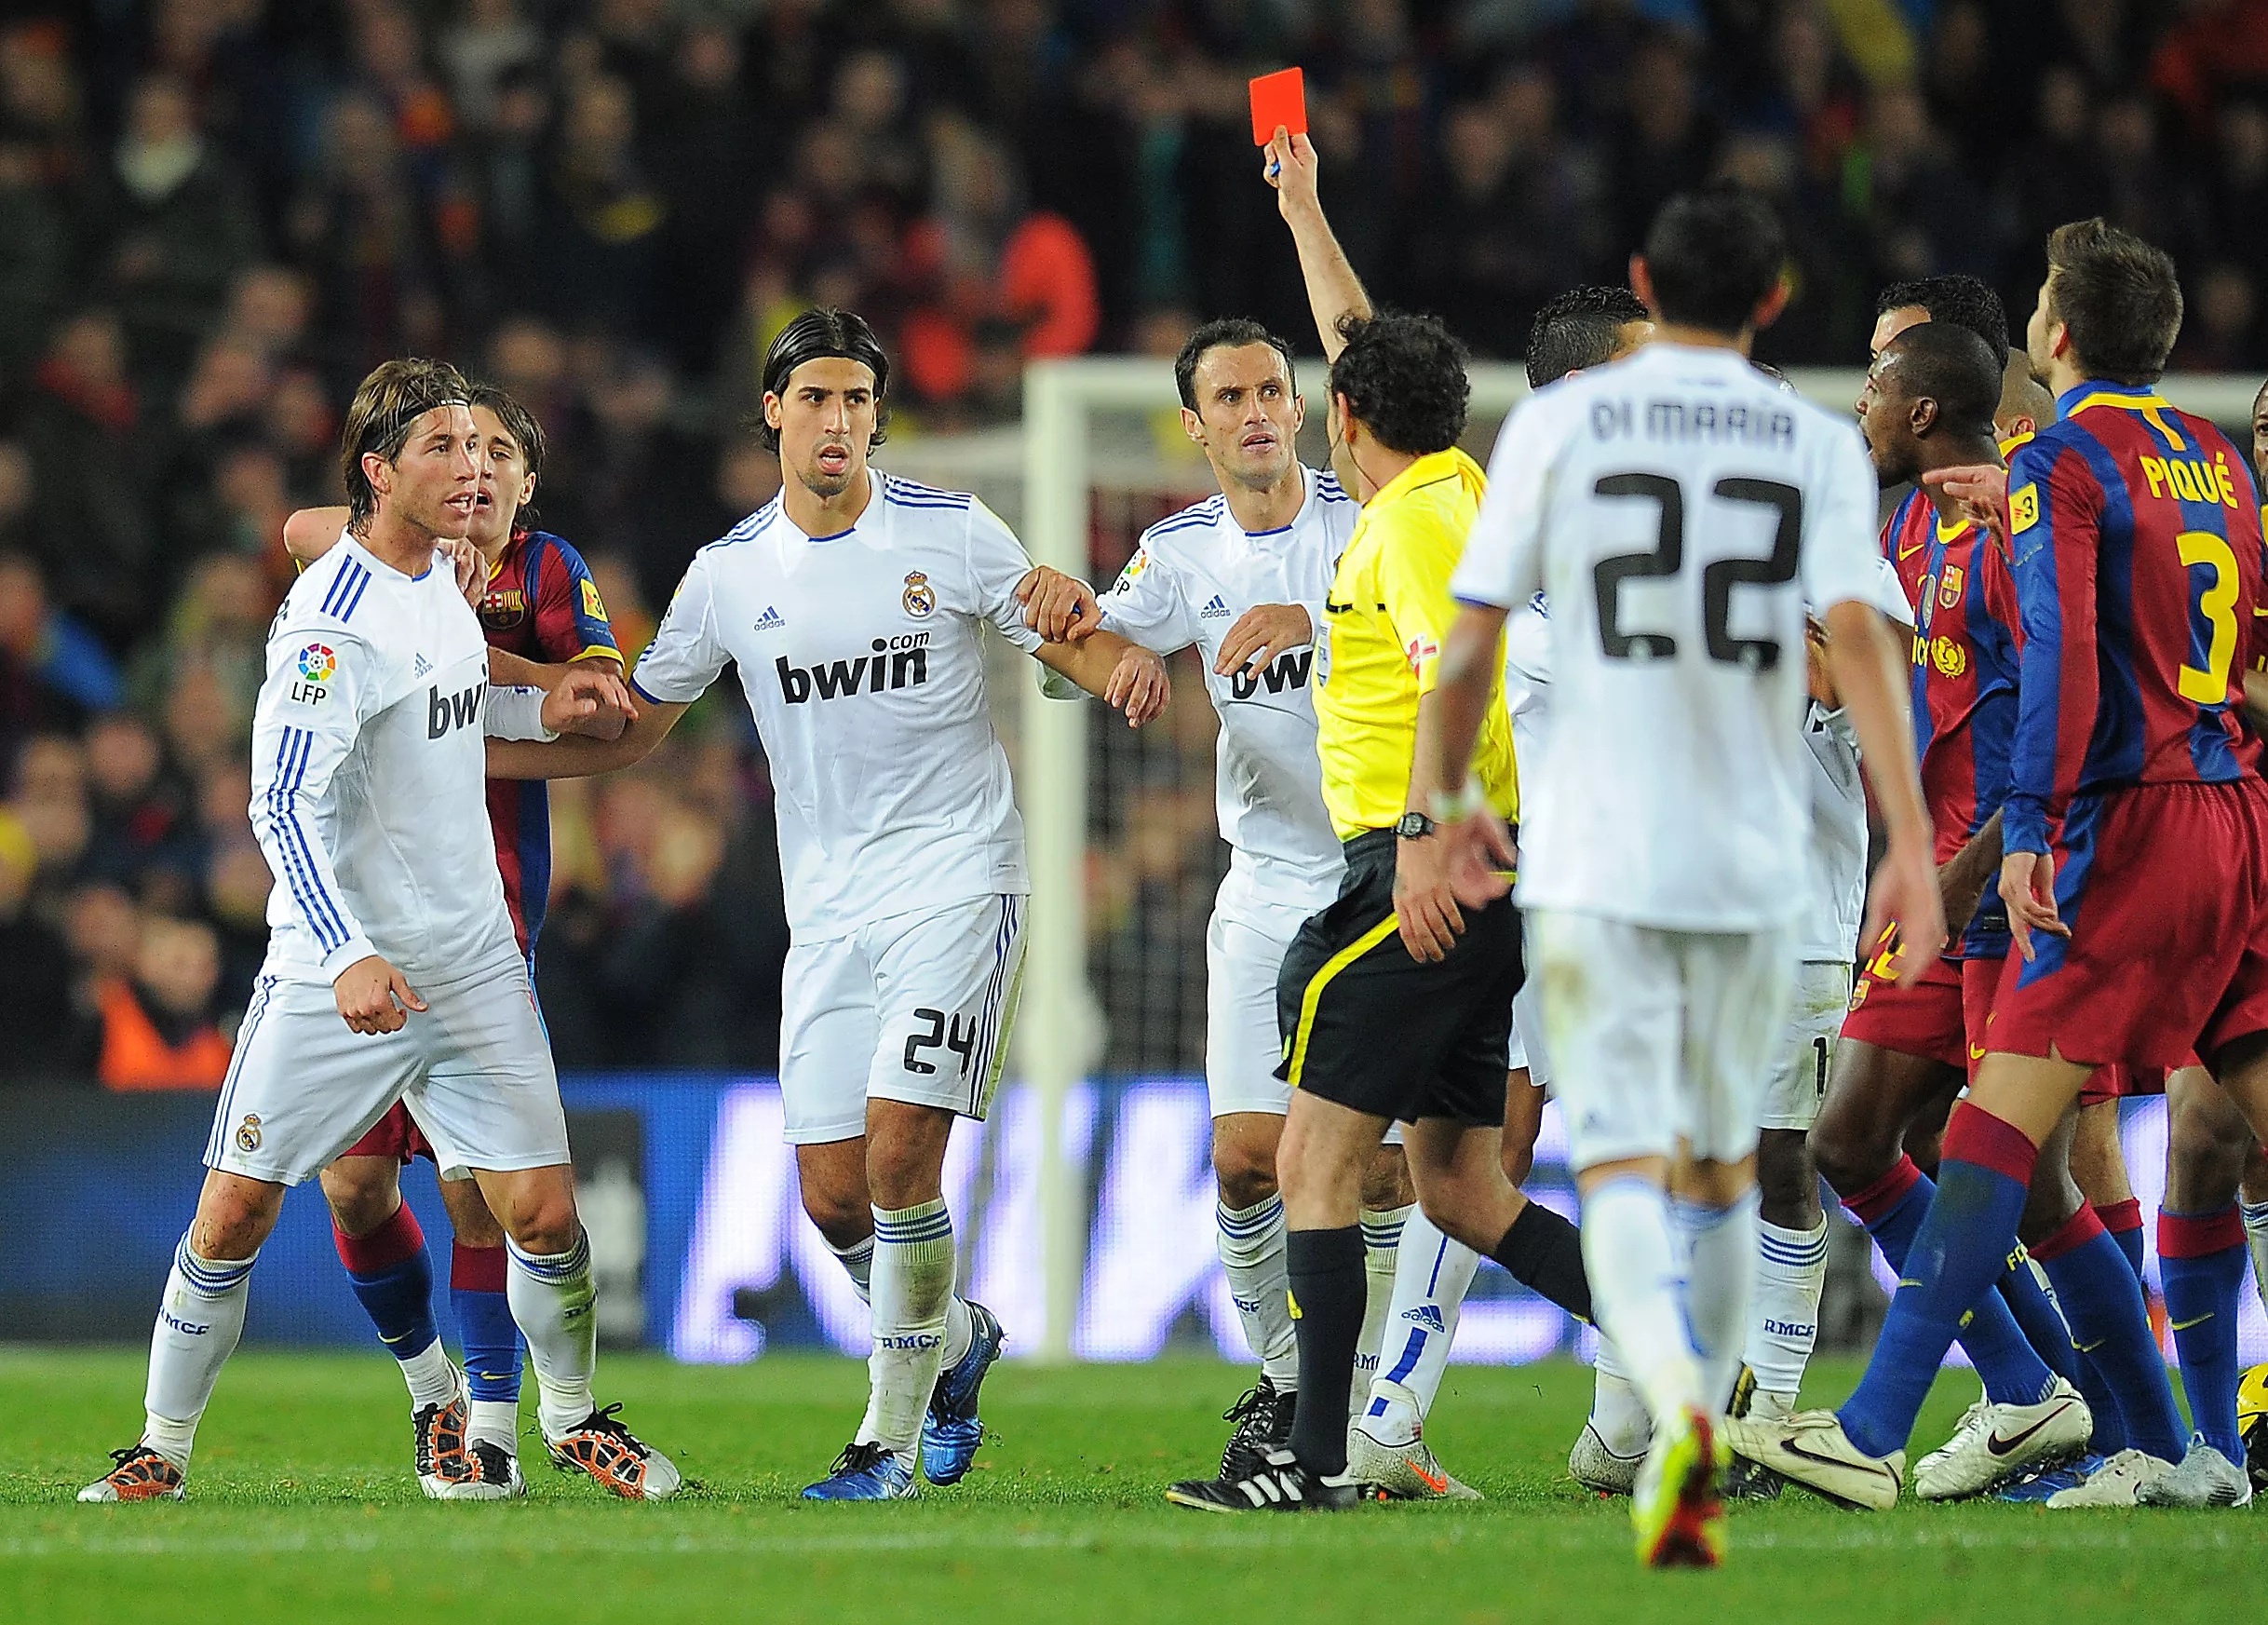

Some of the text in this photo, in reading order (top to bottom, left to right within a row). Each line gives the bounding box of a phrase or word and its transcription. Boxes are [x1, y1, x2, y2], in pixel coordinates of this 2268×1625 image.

[1593, 394, 1635, 441] DI
[2140, 451, 2238, 509] PIQUÉ
[1594, 472, 1802, 667] 22
[753, 618, 786, 631] adidas
[1200, 607, 1232, 619] adidas
[2175, 531, 2240, 705] 3
[889, 631, 930, 650] com
[775, 638, 928, 705] bwin
[290, 682, 327, 706] LFP
[904, 1008, 977, 1081] 24
[1401, 1307, 1445, 1334] adidas
[1764, 1319, 1816, 1337] RMCF
[882, 1334, 942, 1349] RMCF
